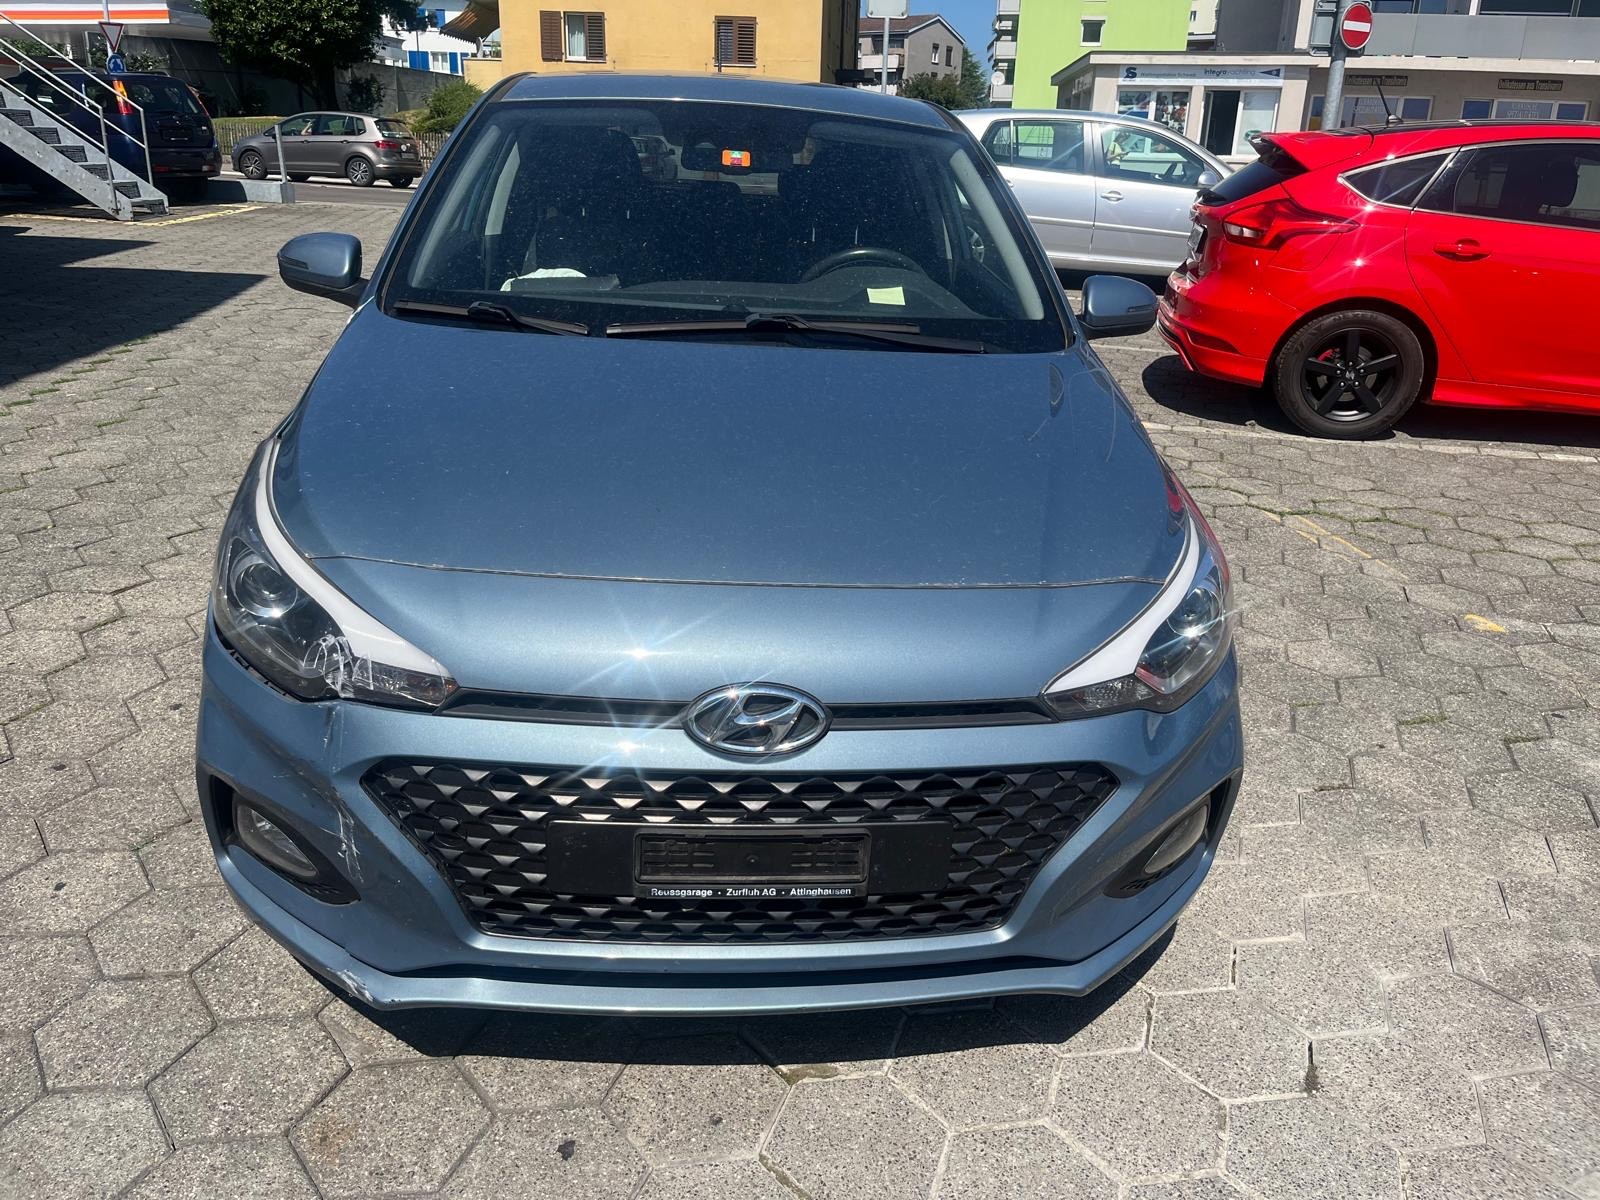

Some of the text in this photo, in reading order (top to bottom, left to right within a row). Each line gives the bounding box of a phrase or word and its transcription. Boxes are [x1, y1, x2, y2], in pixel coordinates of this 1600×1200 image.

[651, 887, 851, 897] Reussgarage Zurfluh AG Attinghausen
